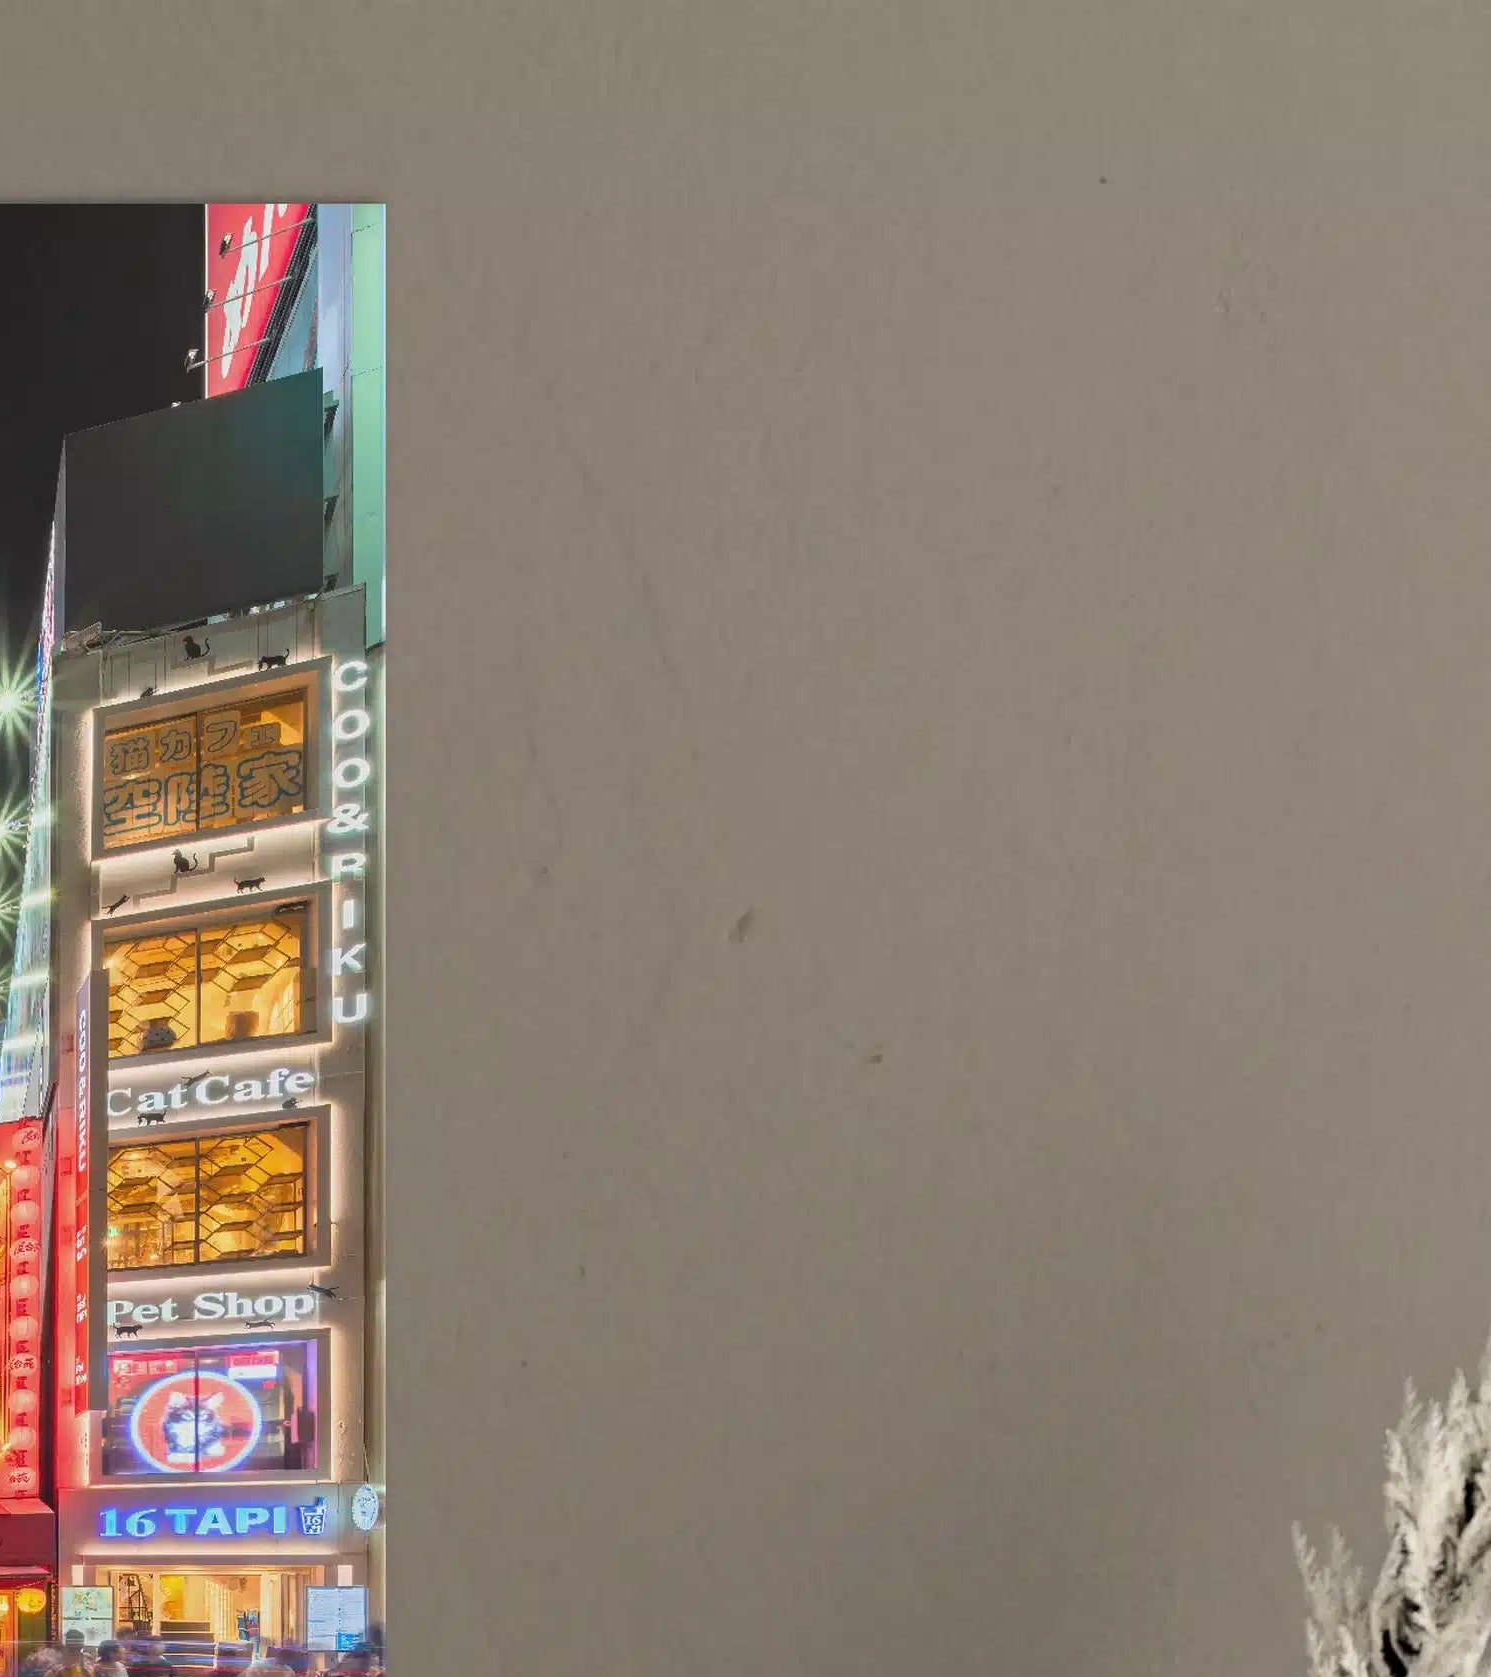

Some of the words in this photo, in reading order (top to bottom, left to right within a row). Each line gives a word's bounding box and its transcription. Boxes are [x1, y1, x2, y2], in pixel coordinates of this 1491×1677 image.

[110, 719, 280, 776] 猫カフェ
[106, 1083, 188, 1118] Cat
[195, 1067, 315, 1105] Cafe
[107, 1297, 180, 1326] Pet
[193, 1290, 316, 1322] Shop
[99, 1508, 157, 1538] 16
[164, 1505, 288, 1536] TAPI
